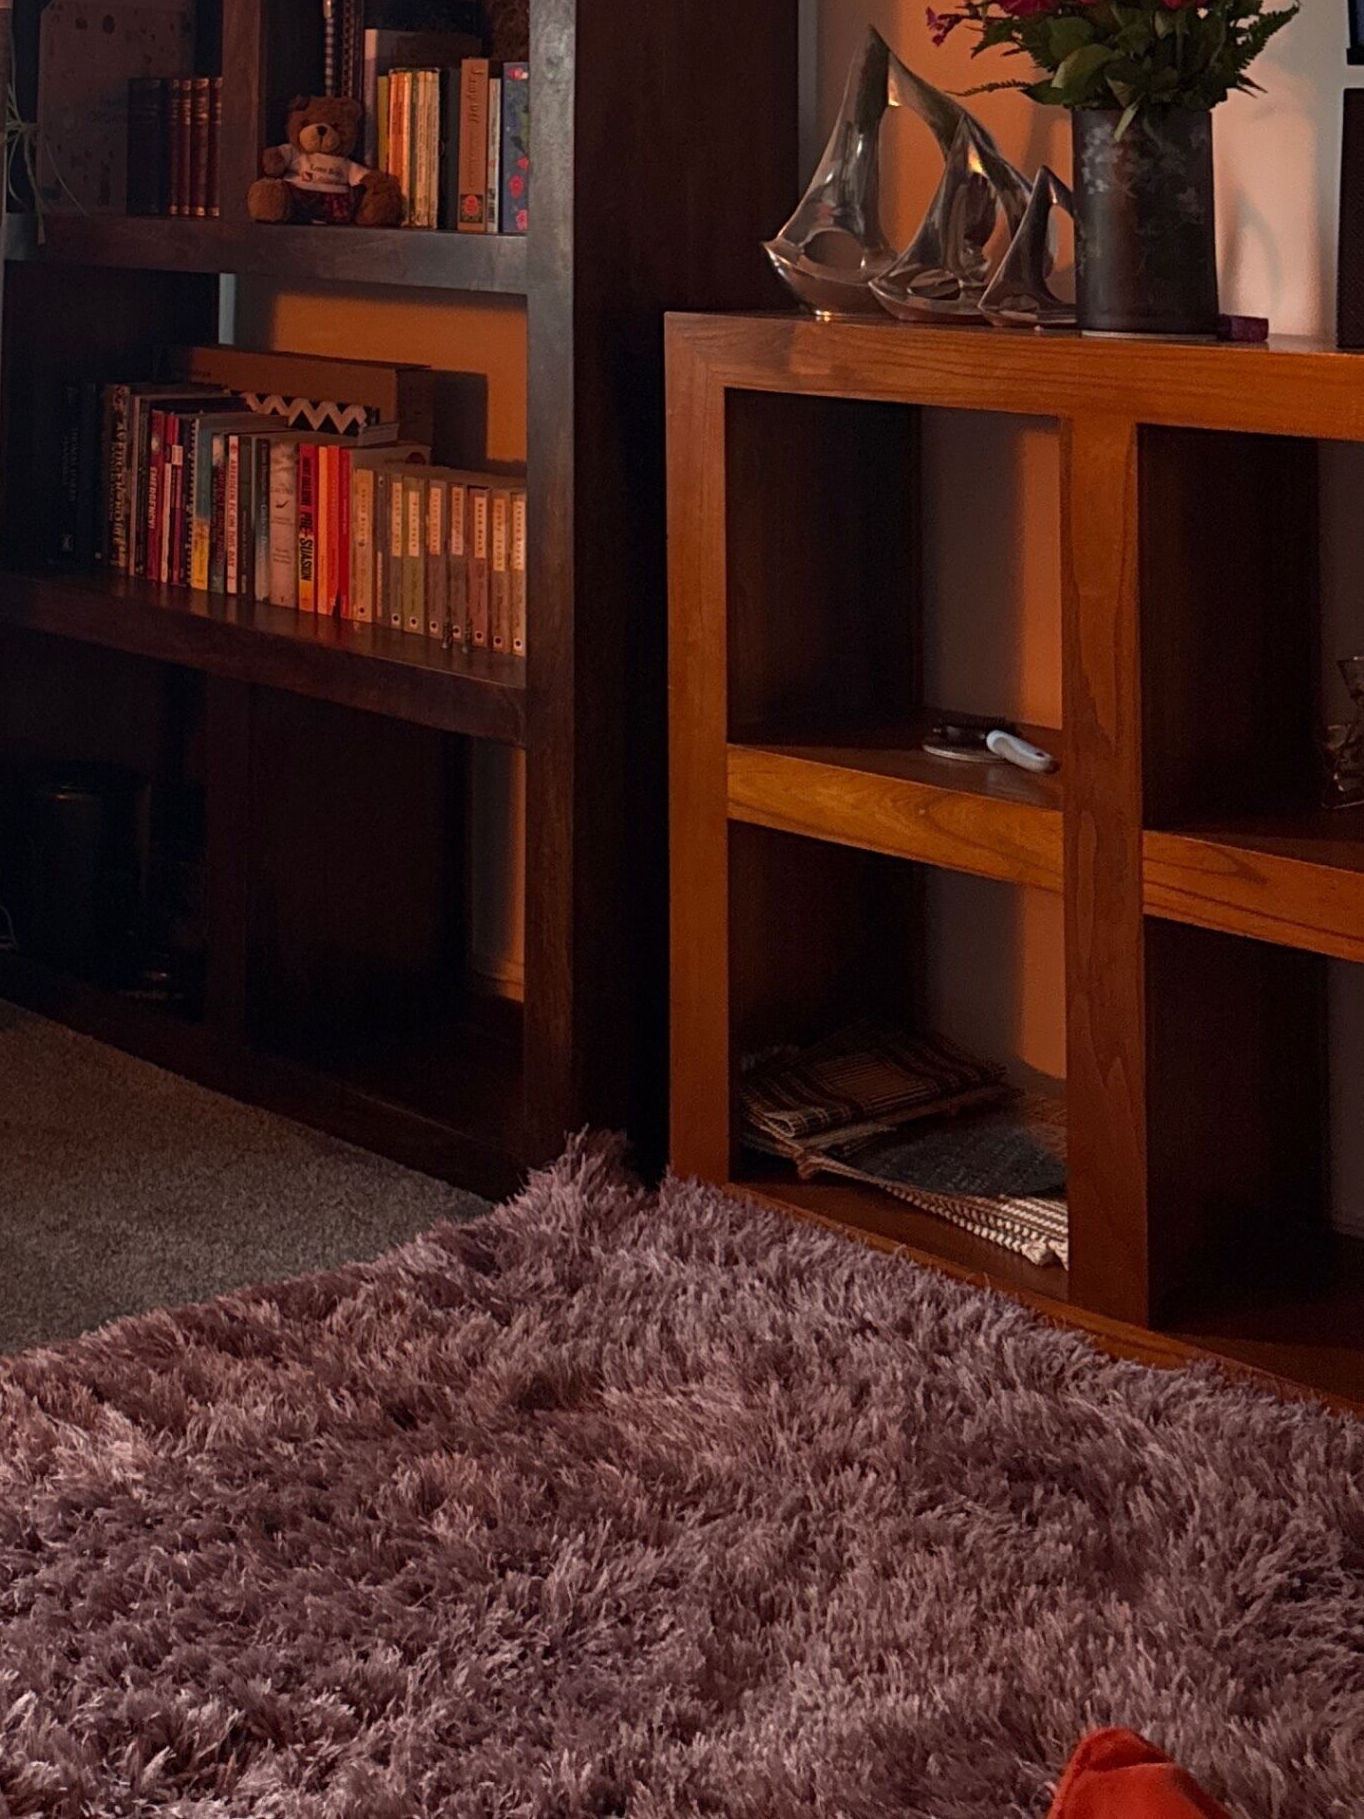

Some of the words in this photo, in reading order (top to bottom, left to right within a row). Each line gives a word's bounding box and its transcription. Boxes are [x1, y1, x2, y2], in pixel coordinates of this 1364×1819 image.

[229, 459, 237, 500] ABERDEEN
[228, 530, 236, 548] THIS
[299, 511, 313, 581] PRE-SUASION
[227, 550, 235, 568] DAY
